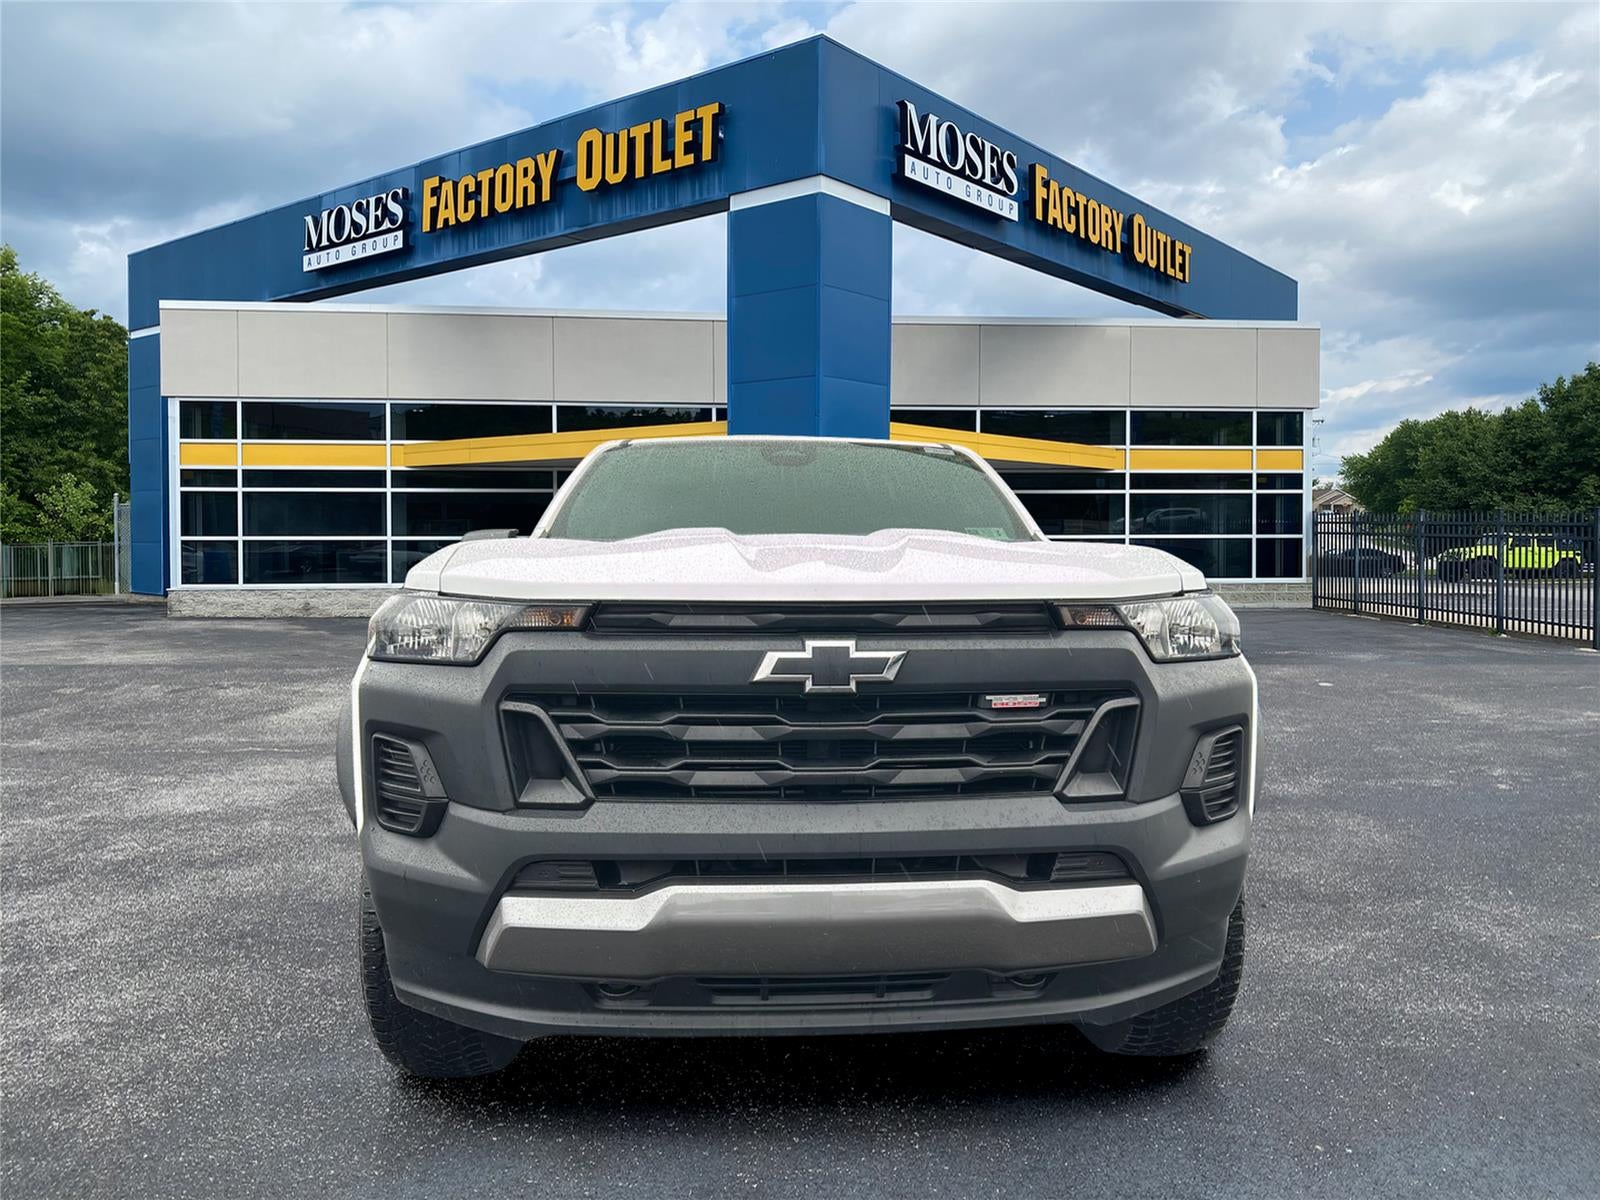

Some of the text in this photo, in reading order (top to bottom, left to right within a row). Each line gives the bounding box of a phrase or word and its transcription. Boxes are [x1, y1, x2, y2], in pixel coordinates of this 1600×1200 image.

[422, 102, 720, 233] FACTORY OUTLET
[903, 100, 1018, 196] MOSES
[910, 161, 1014, 215] AUTO GROUP
[303, 187, 404, 251] MOSES
[307, 234, 400, 267] AUTO GROUP
[1034, 163, 1192, 284] FACTORY OUTLET
